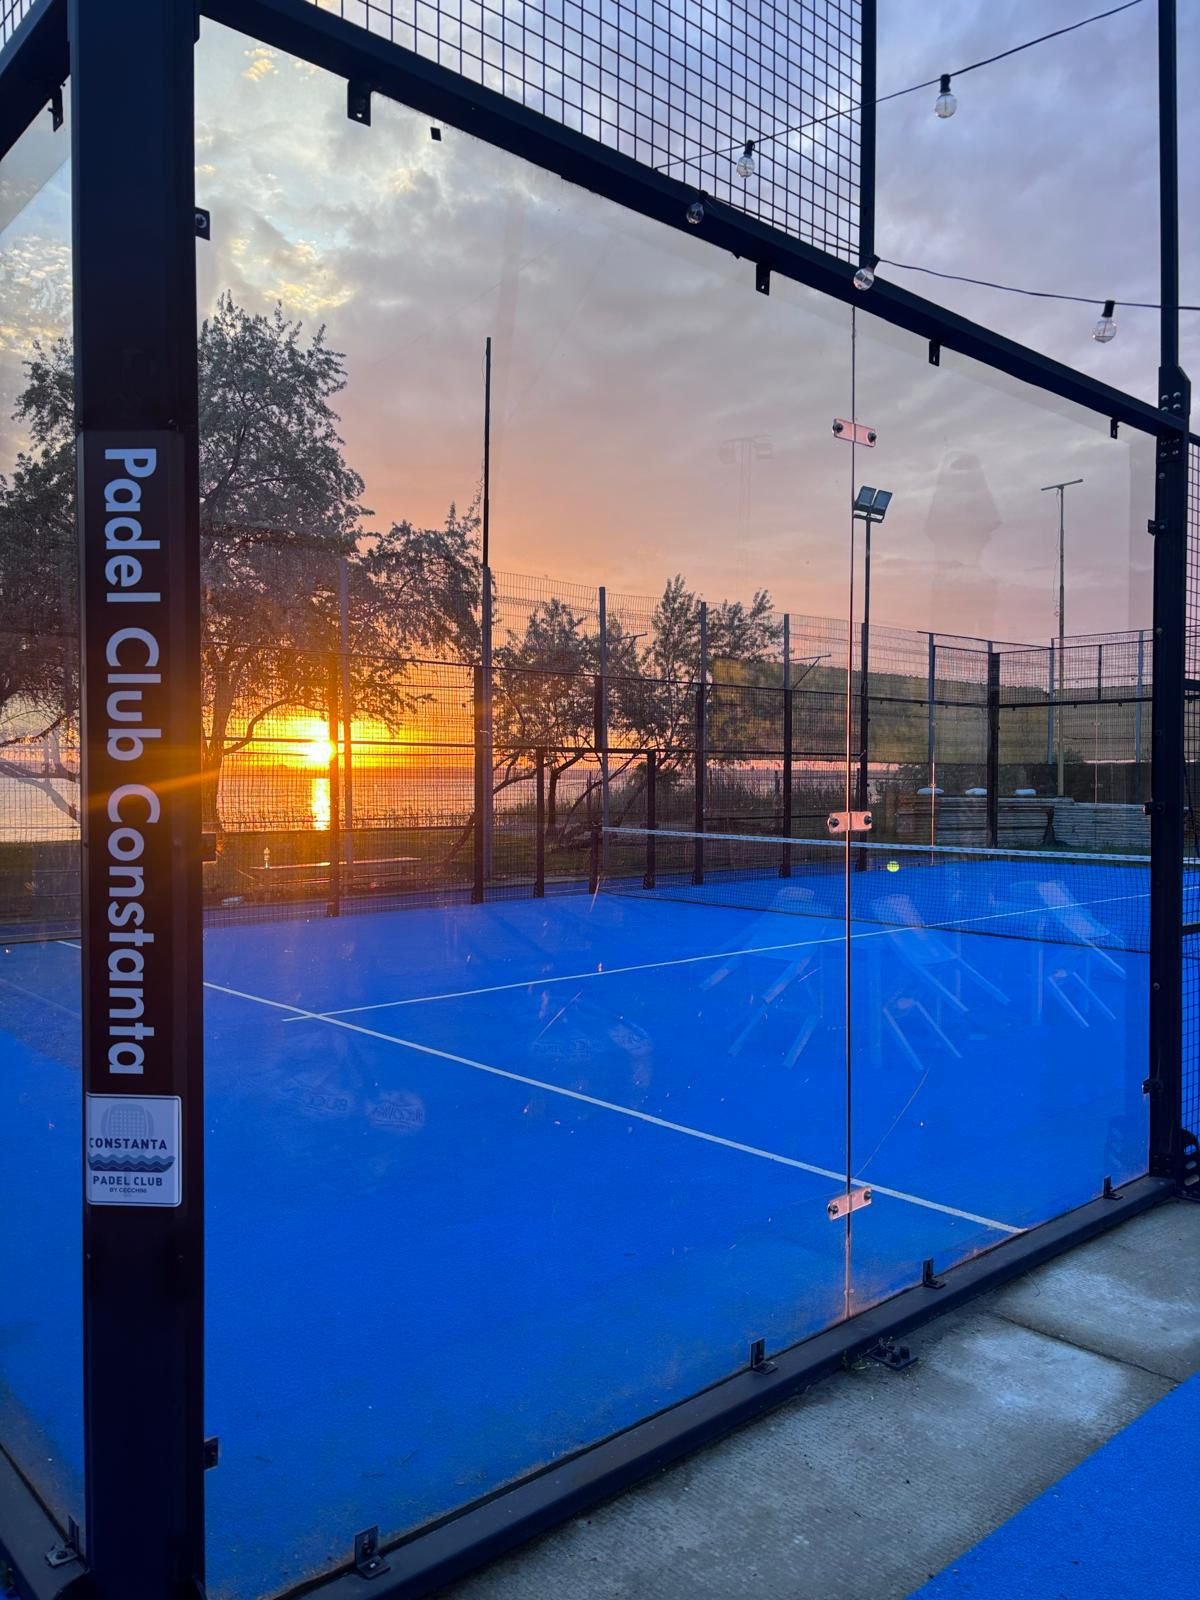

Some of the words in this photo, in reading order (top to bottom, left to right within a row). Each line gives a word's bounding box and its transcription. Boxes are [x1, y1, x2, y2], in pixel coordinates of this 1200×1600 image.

[104, 448, 161, 603] Padel
[106, 627, 162, 761] Club
[107, 783, 161, 1075] Constanta
[89, 1137, 167, 1150] CONSTANTA
[93, 1175, 130, 1185] PADEL
[134, 1176, 163, 1186] CLUB
